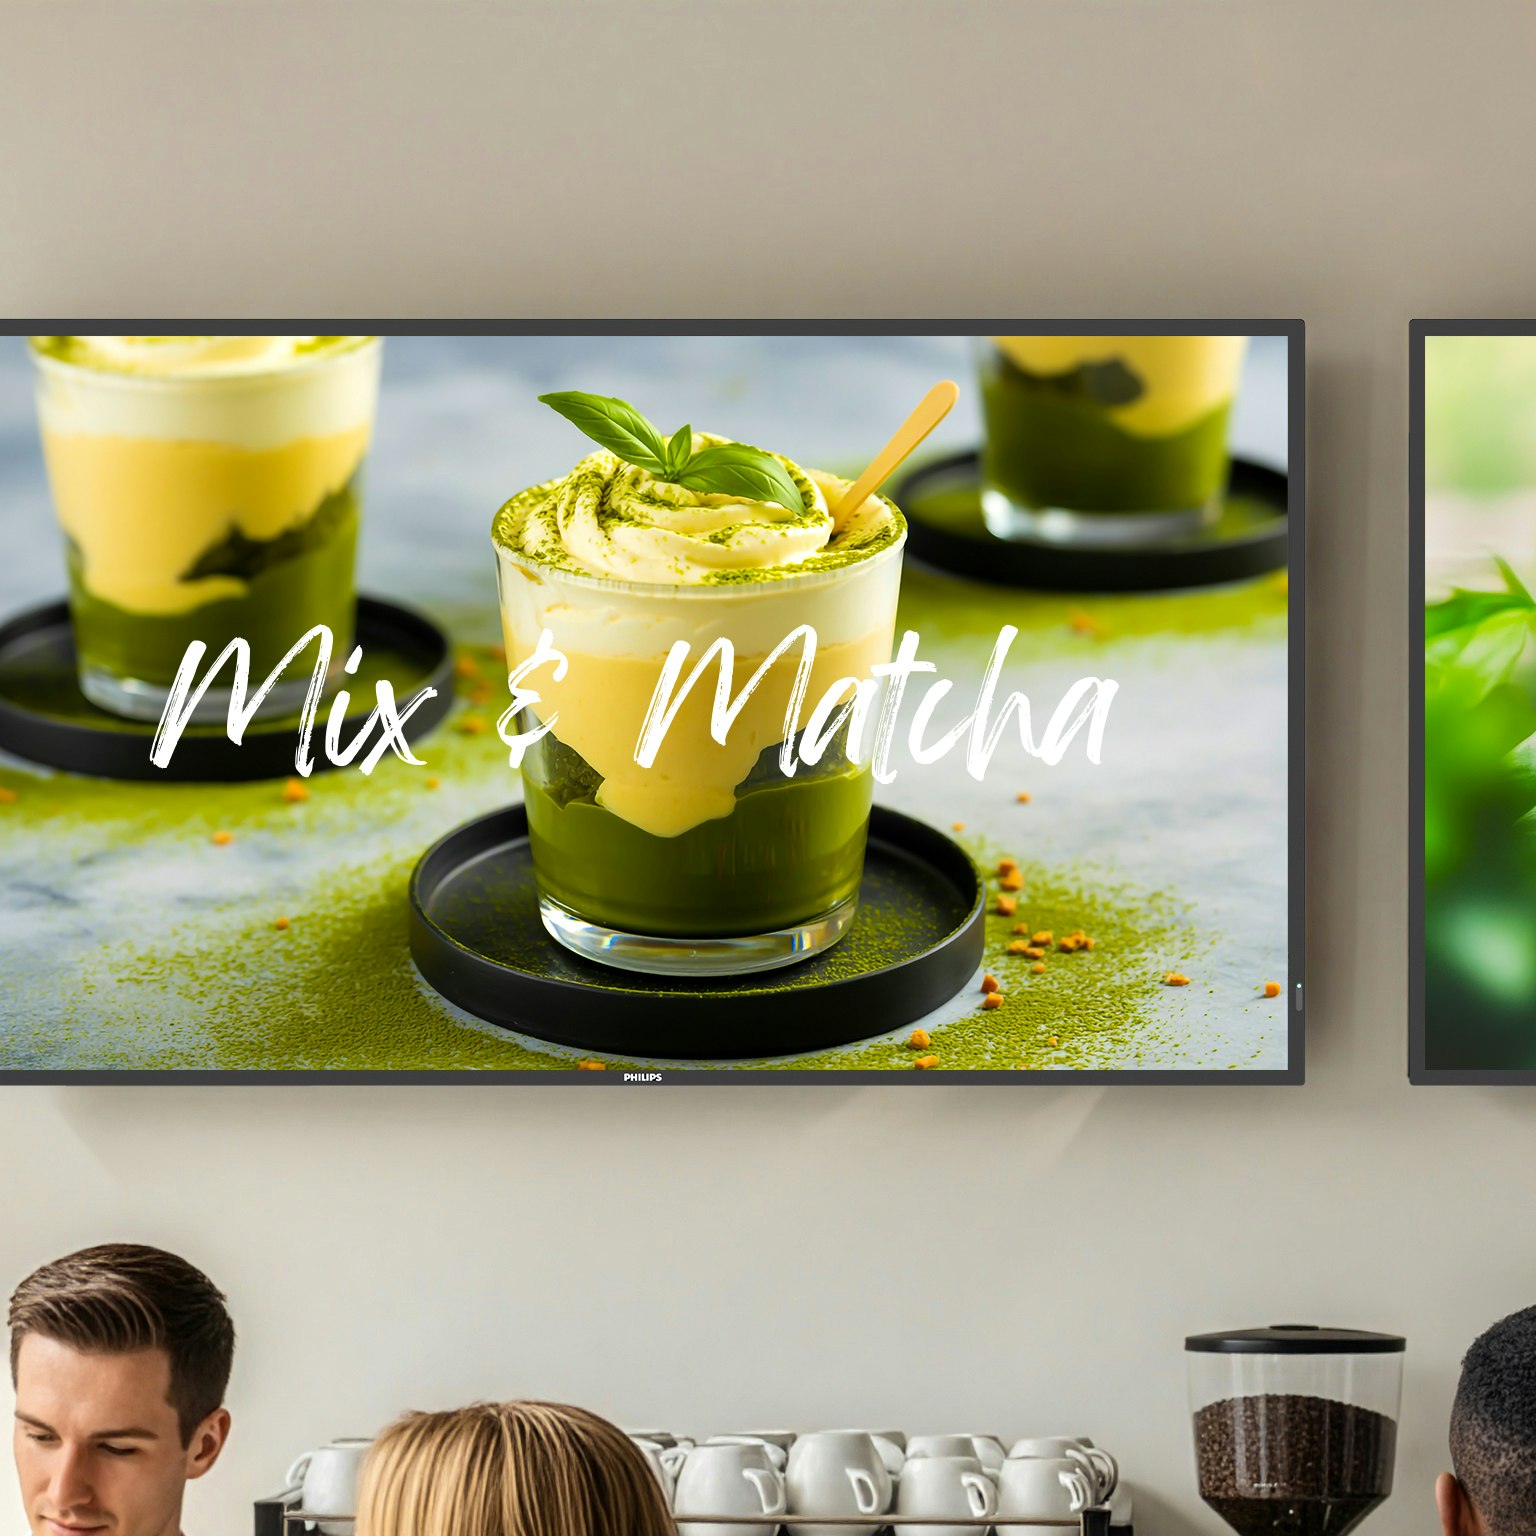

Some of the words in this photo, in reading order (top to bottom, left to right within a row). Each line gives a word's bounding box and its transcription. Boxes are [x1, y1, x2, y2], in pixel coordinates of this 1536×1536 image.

[149, 624, 439, 778] Mix
[496, 628, 569, 769] &
[635, 624, 1121, 786] Matcha
[623, 1073, 663, 1082] PHILIPS
